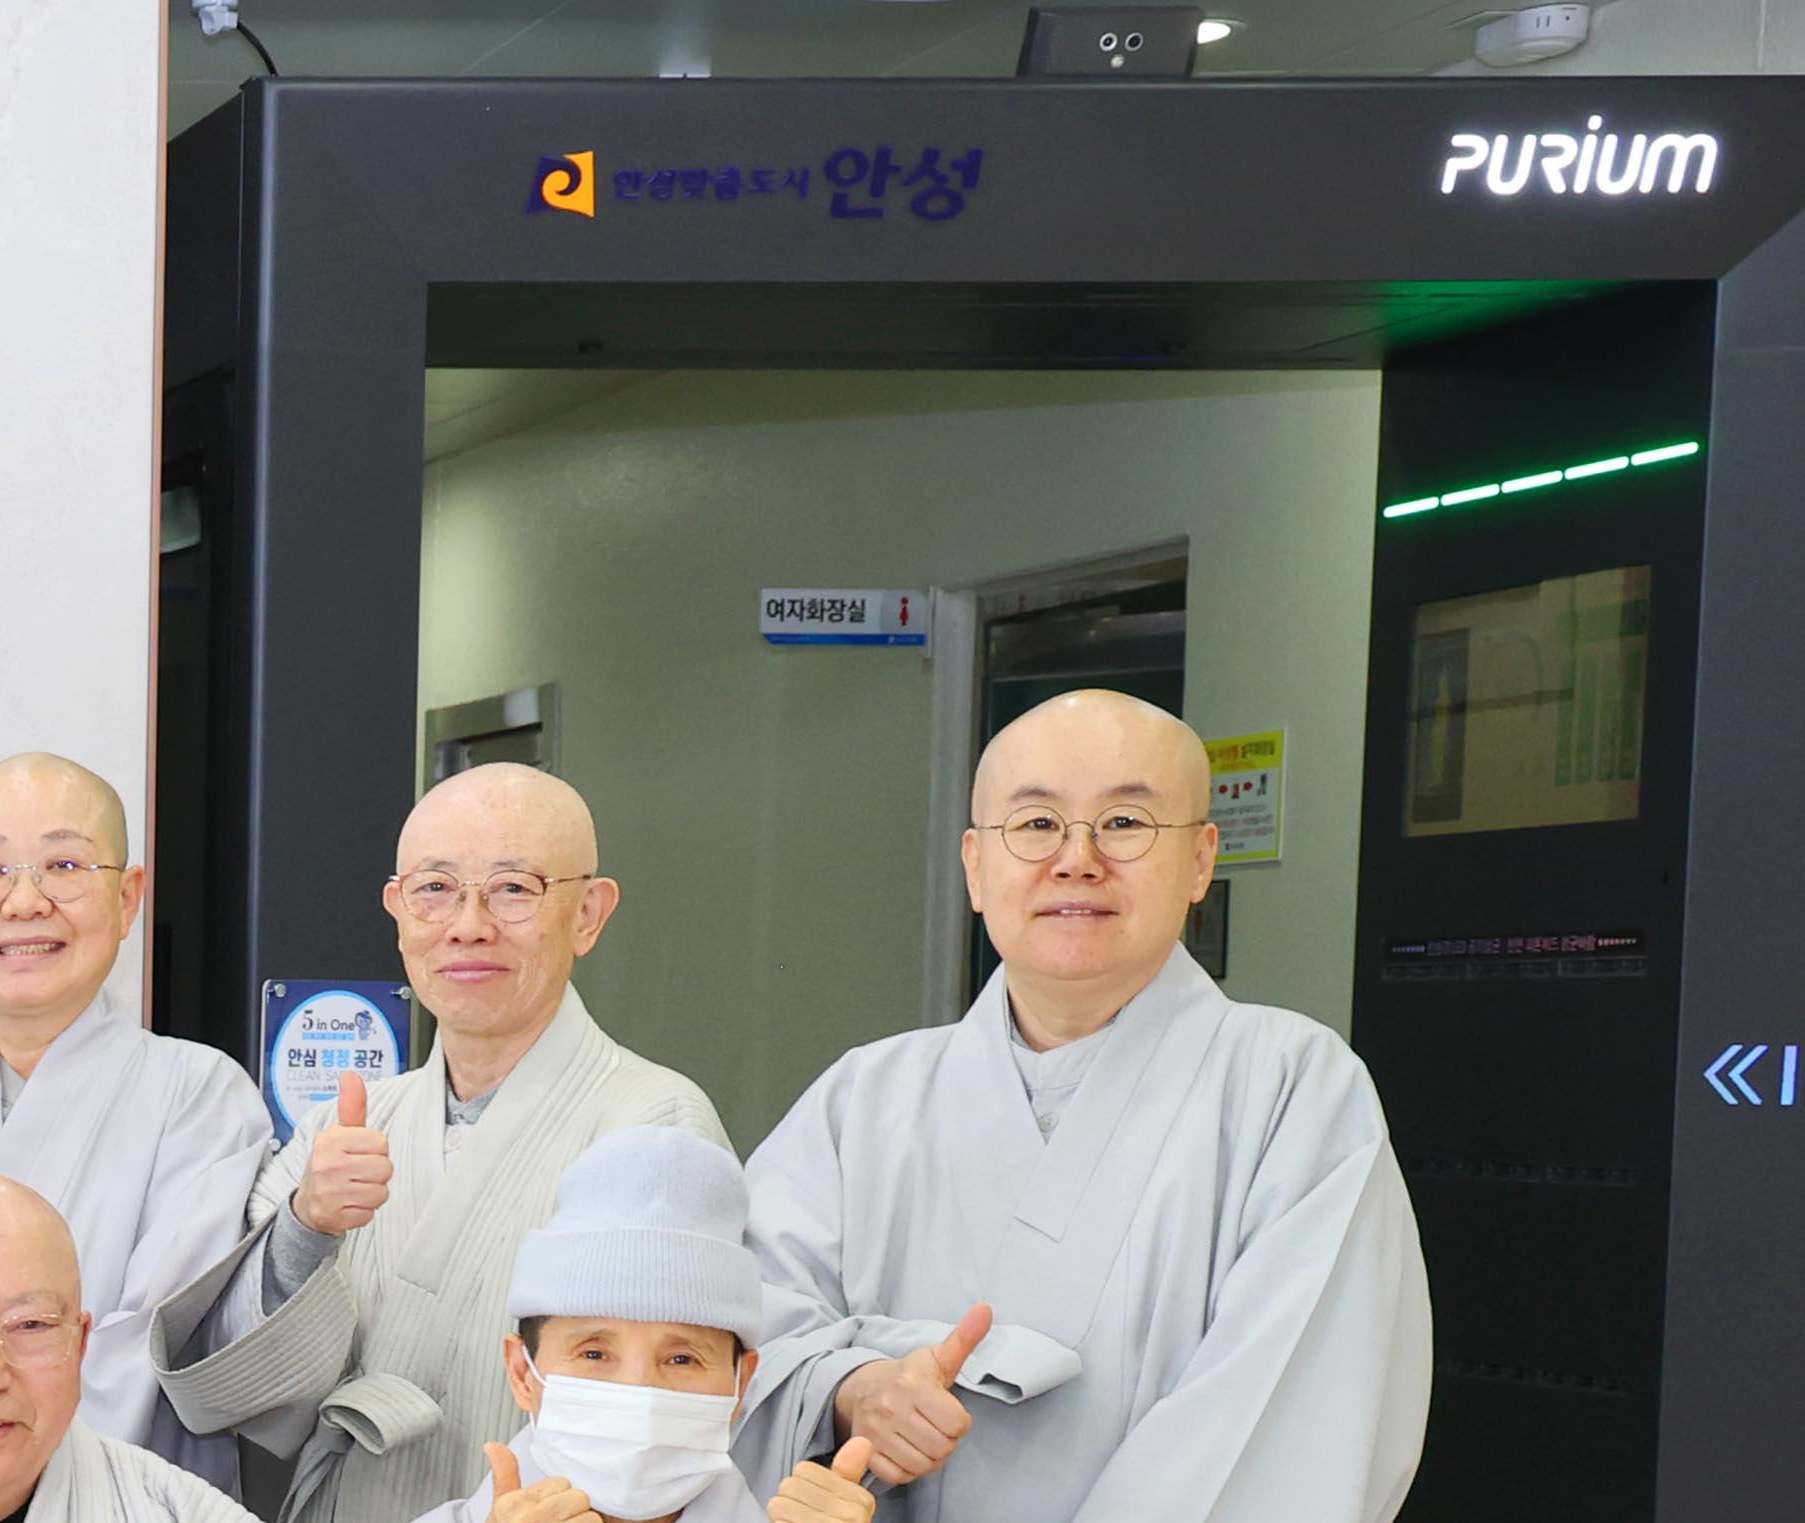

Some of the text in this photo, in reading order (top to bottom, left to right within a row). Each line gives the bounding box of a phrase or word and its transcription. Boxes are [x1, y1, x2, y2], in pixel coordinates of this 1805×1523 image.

[823, 147, 983, 221] 안성
[766, 598, 866, 623] 여자화장실
[303, 1009, 355, 1031] 5 in One
[288, 1049, 383, 1068] 안심 청정 공간
[287, 1070, 320, 1081] CLEAN
